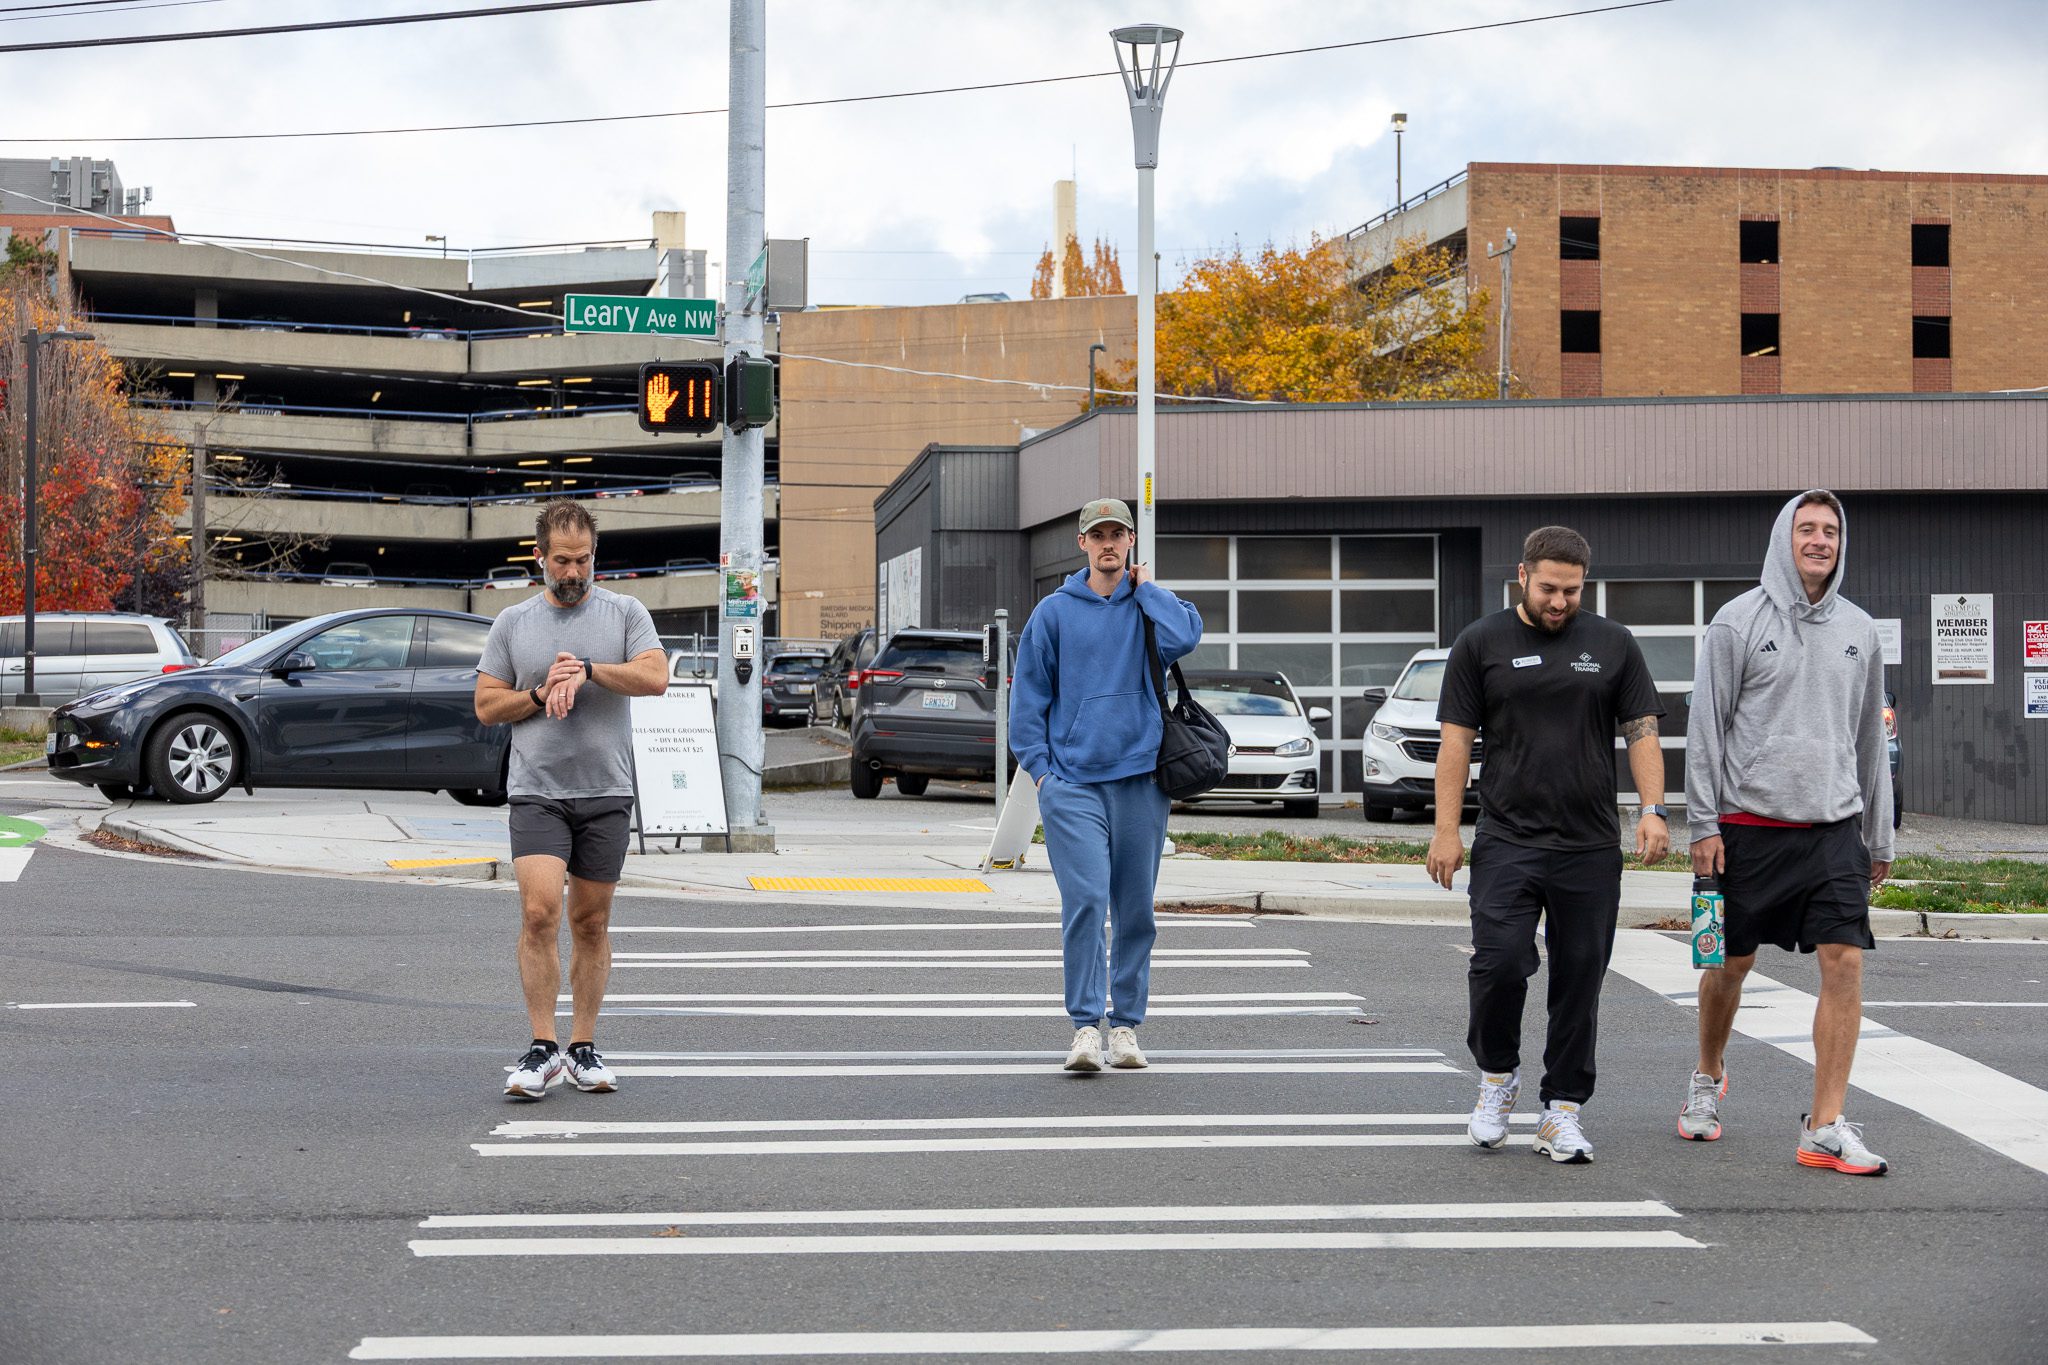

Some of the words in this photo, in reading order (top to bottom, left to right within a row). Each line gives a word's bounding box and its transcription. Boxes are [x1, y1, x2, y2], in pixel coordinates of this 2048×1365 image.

[569, 298, 640, 332] Leary
[646, 308, 677, 328] Ave
[685, 310, 713, 329] NW
[688, 379, 711, 418] 11
[820, 619, 862, 630] Shipping
[1936, 619, 1988, 627] MEMBER
[1937, 628, 1988, 637] PARKING
